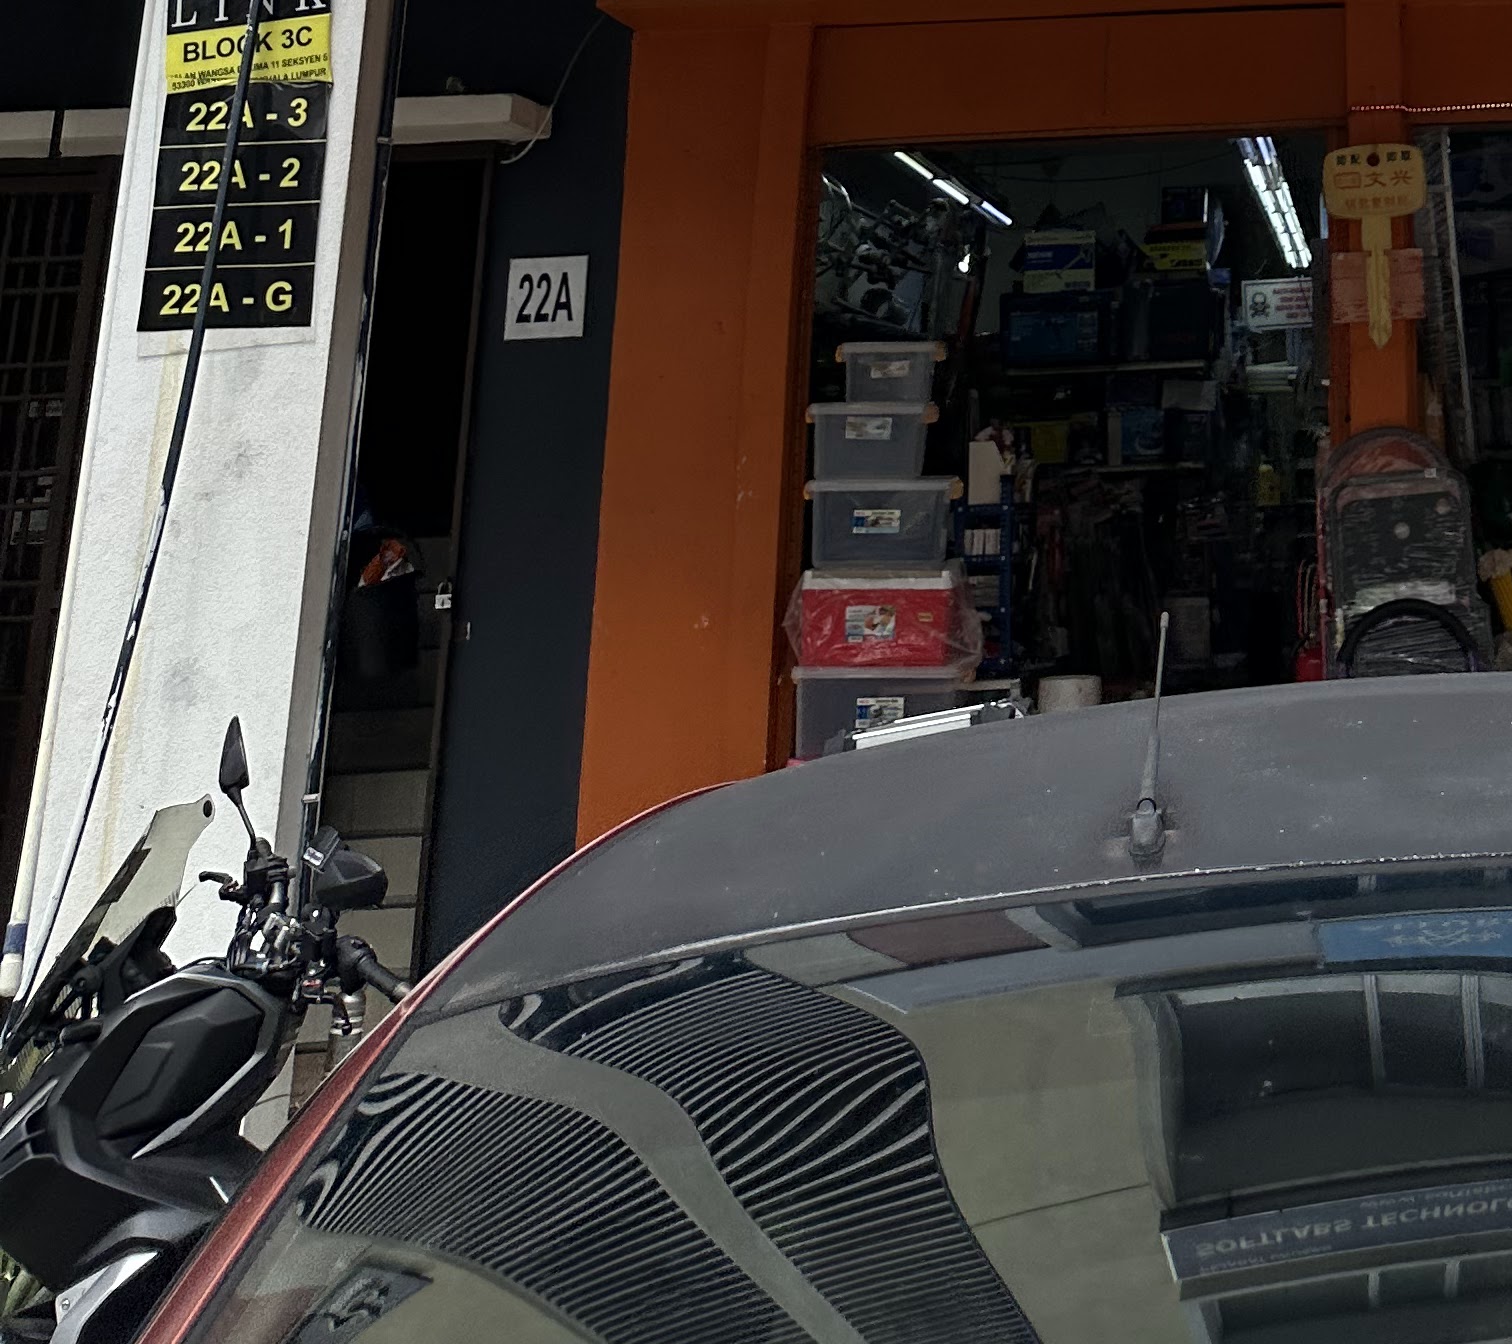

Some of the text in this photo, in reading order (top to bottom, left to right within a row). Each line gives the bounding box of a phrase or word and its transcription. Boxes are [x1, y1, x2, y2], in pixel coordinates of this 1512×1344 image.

[281, 26, 313, 49] 3C
[186, 100, 254, 132] 22A
[287, 98, 308, 127] 3
[178, 160, 247, 192] 22A
[279, 157, 301, 188] 2
[174, 221, 243, 253] 22A
[278, 218, 294, 249] 1
[159, 283, 230, 316] 22A
[265, 281, 293, 312] G
[516, 272, 573, 323] 22A
